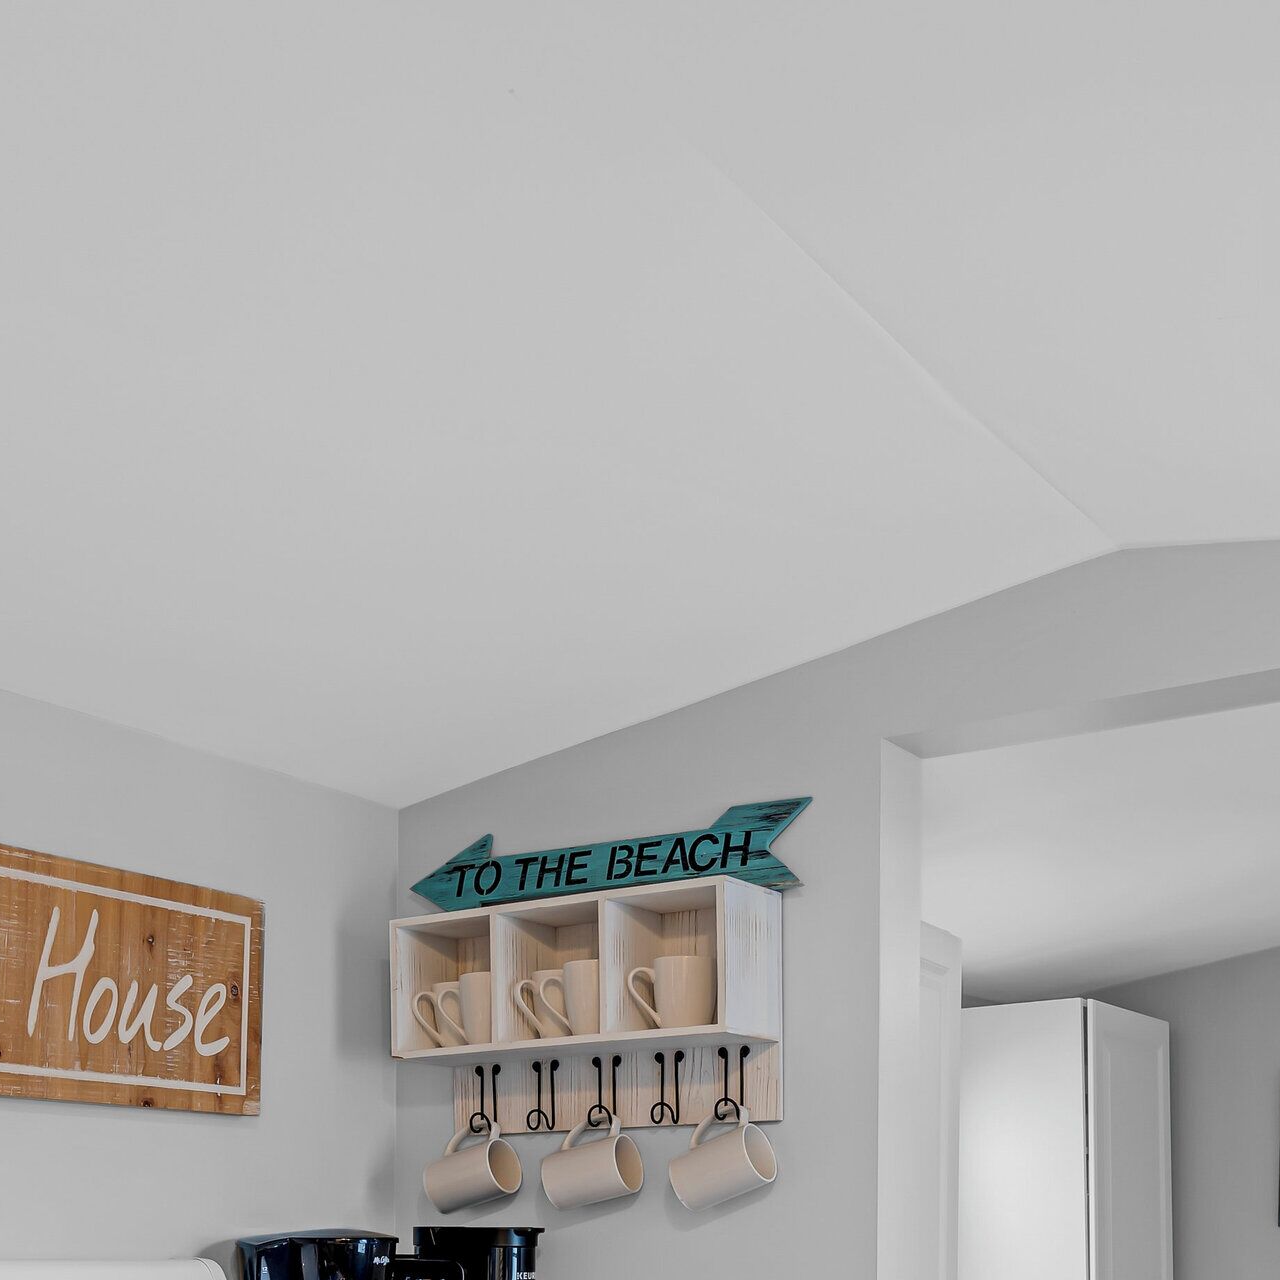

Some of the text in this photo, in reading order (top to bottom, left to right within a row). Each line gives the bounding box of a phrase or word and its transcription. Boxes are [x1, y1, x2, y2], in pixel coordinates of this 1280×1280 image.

[451, 830, 752, 898] TO THE BEACH
[26, 906, 232, 1057] House
